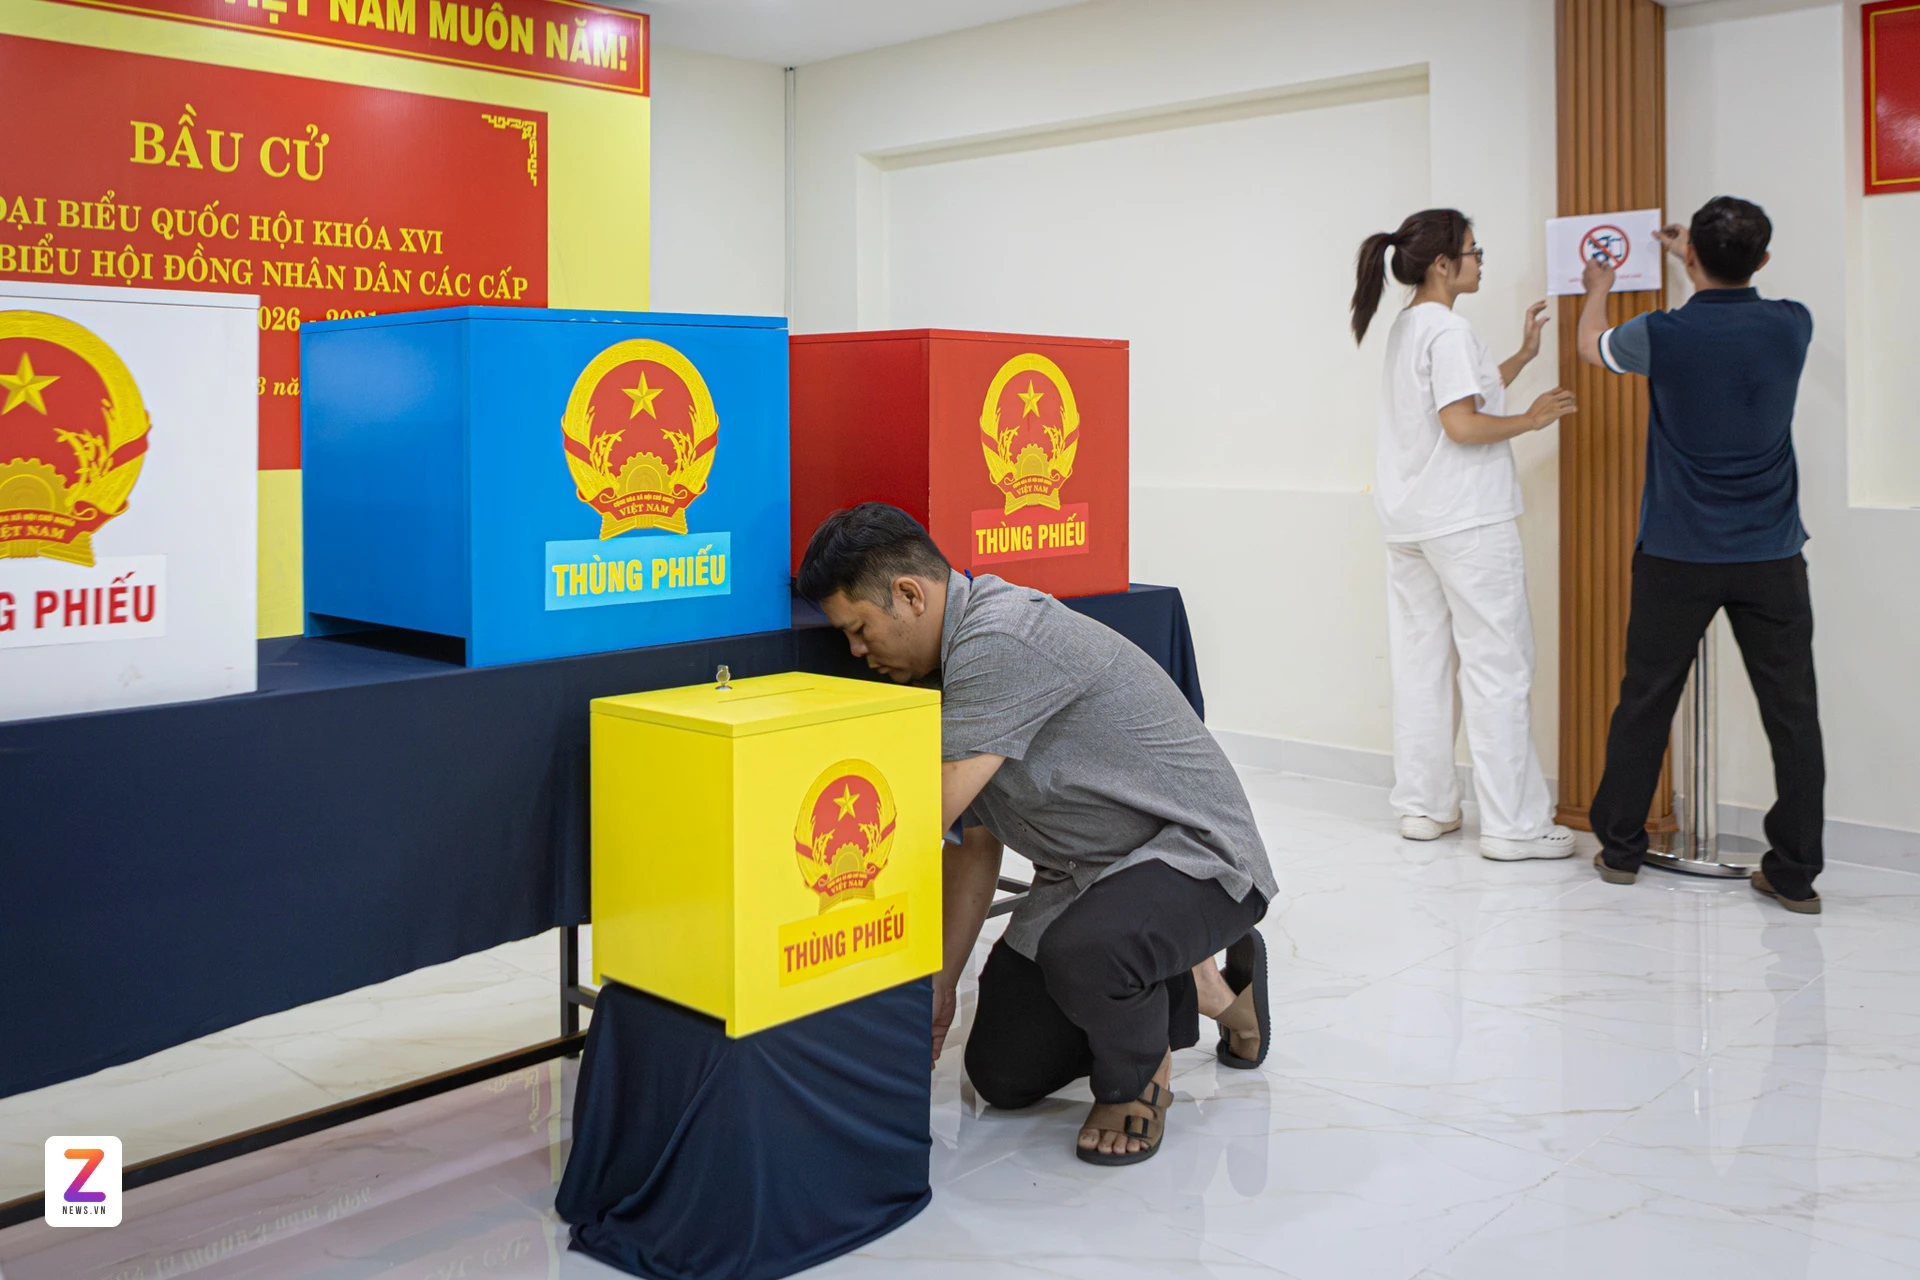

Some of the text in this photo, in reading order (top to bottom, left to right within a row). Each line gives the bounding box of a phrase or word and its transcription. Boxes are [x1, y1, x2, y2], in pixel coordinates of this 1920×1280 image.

[329, 0, 416, 36] NAM
[429, 0, 534, 55] MUÔN
[546, 17, 628, 72] NĂM!
[130, 103, 330, 182] BẦU CỬ
[57, 189, 142, 233] BIỂU
[151, 200, 240, 241] QUỐC
[249, 210, 304, 250] HỘI
[312, 217, 392, 250] KHÓA
[399, 227, 443, 254] XVI
[0, 232, 529, 300] BIỂU HỘI ĐỒNG NHÂN DÂN CÁC CẤP
[618, 502, 669, 516] VIỆT NAM
[1033, 485, 1049, 494] NAM
[26, 524, 67, 539] NAM
[975, 513, 1086, 555] THÙNG PHIẾU
[552, 544, 726, 597] THÙNG PHIẾU
[34, 571, 156, 630] PHIẾU
[784, 904, 905, 974] THÙNG PHIẾU
